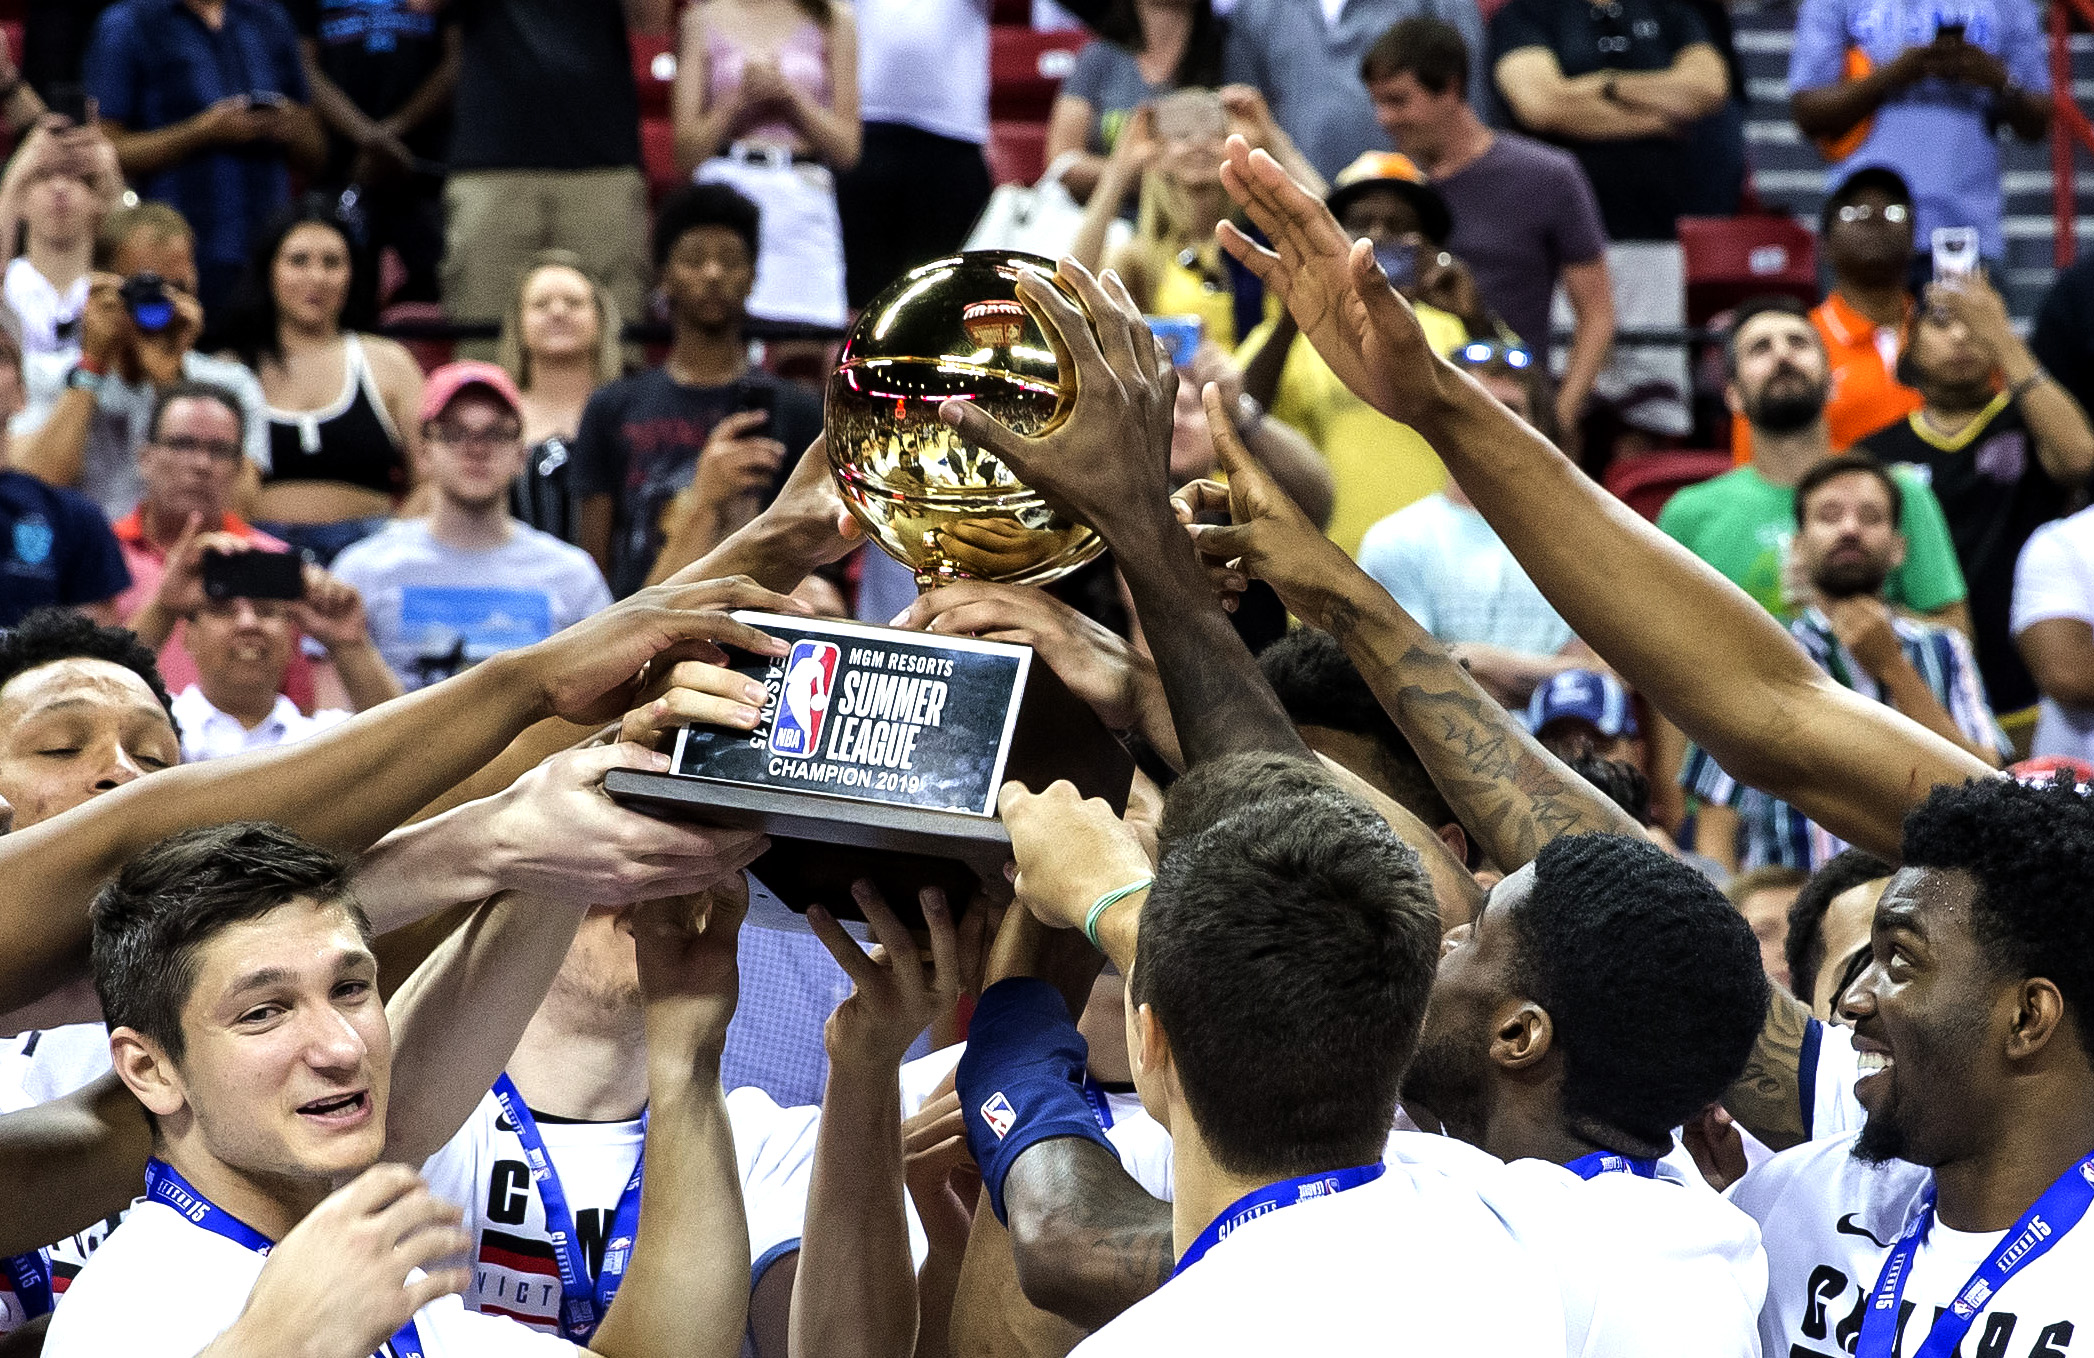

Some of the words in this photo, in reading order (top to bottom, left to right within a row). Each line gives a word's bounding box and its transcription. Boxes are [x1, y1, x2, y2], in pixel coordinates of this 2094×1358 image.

[849, 648, 885, 668] MGM
[888, 652, 954, 677] RESORTS
[761, 656, 786, 724] EASON
[838, 669, 948, 727] SUMMER
[775, 727, 802, 749] NBA
[826, 715, 921, 770] LEAGUE
[768, 757, 872, 788] CHAMPION
[875, 771, 920, 794] 2019
[185, 1200, 211, 1222] 15
[1997, 1231, 2036, 1273] SEASON
[2027, 1214, 2052, 1242] 15
[1875, 1292, 1895, 1310] 15
